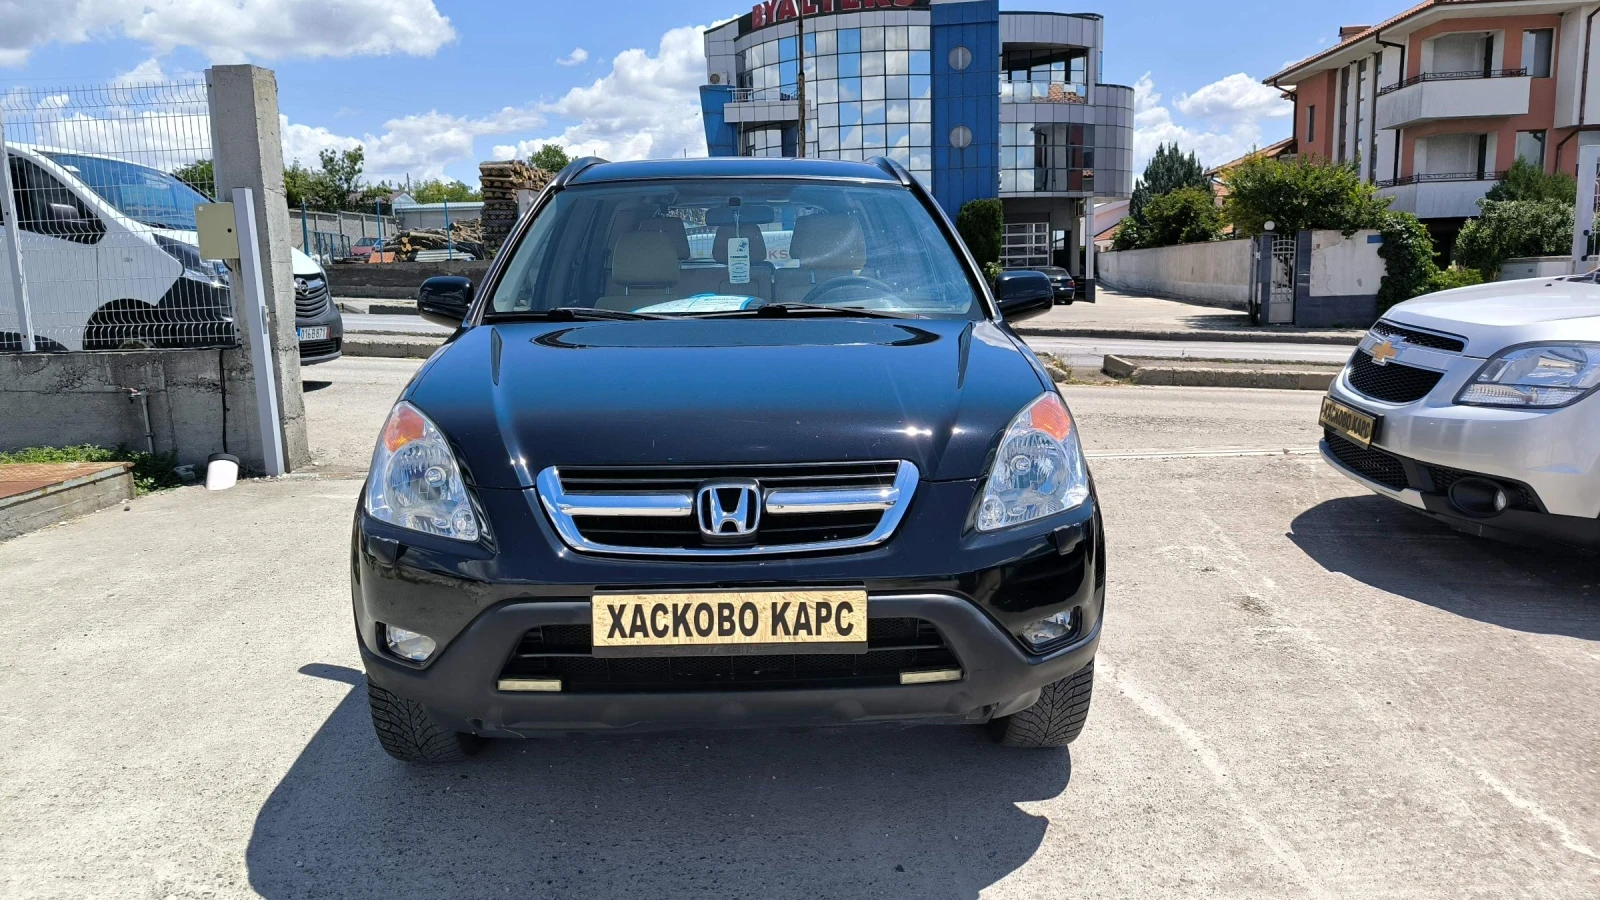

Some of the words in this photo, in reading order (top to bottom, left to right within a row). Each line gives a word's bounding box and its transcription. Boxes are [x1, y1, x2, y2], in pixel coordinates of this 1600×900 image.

[751, 0, 915, 29] BYAL
[1323, 402, 1351, 430] ХАСКОВО
[1352, 416, 1371, 439] КАРС
[607, 601, 759, 639] ХАСКОВО
[771, 601, 854, 636] КАРС
